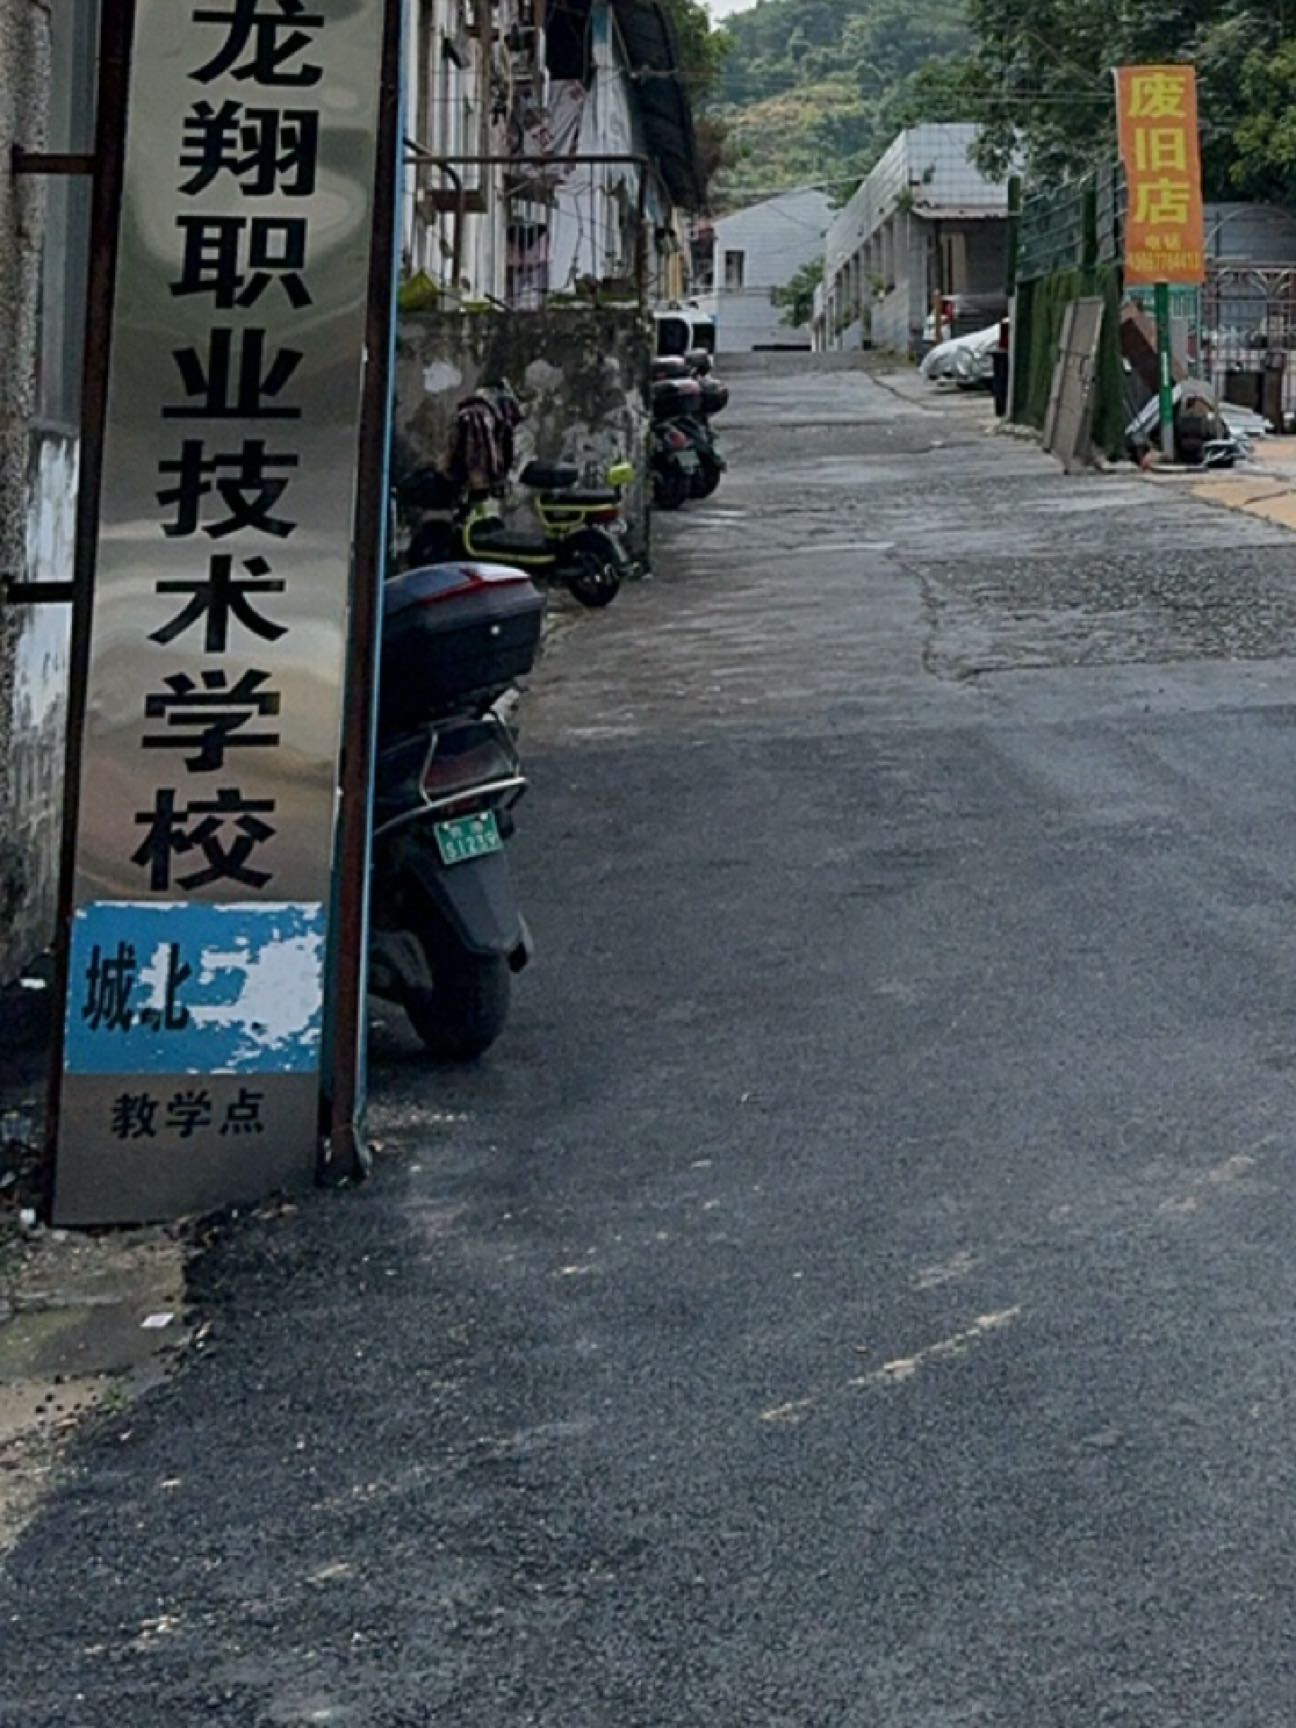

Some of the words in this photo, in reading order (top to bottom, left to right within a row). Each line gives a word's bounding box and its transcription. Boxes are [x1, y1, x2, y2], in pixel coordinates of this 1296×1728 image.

[1128, 72, 1190, 224] 废旧店
[110, 1087, 265, 1139] 教学点
